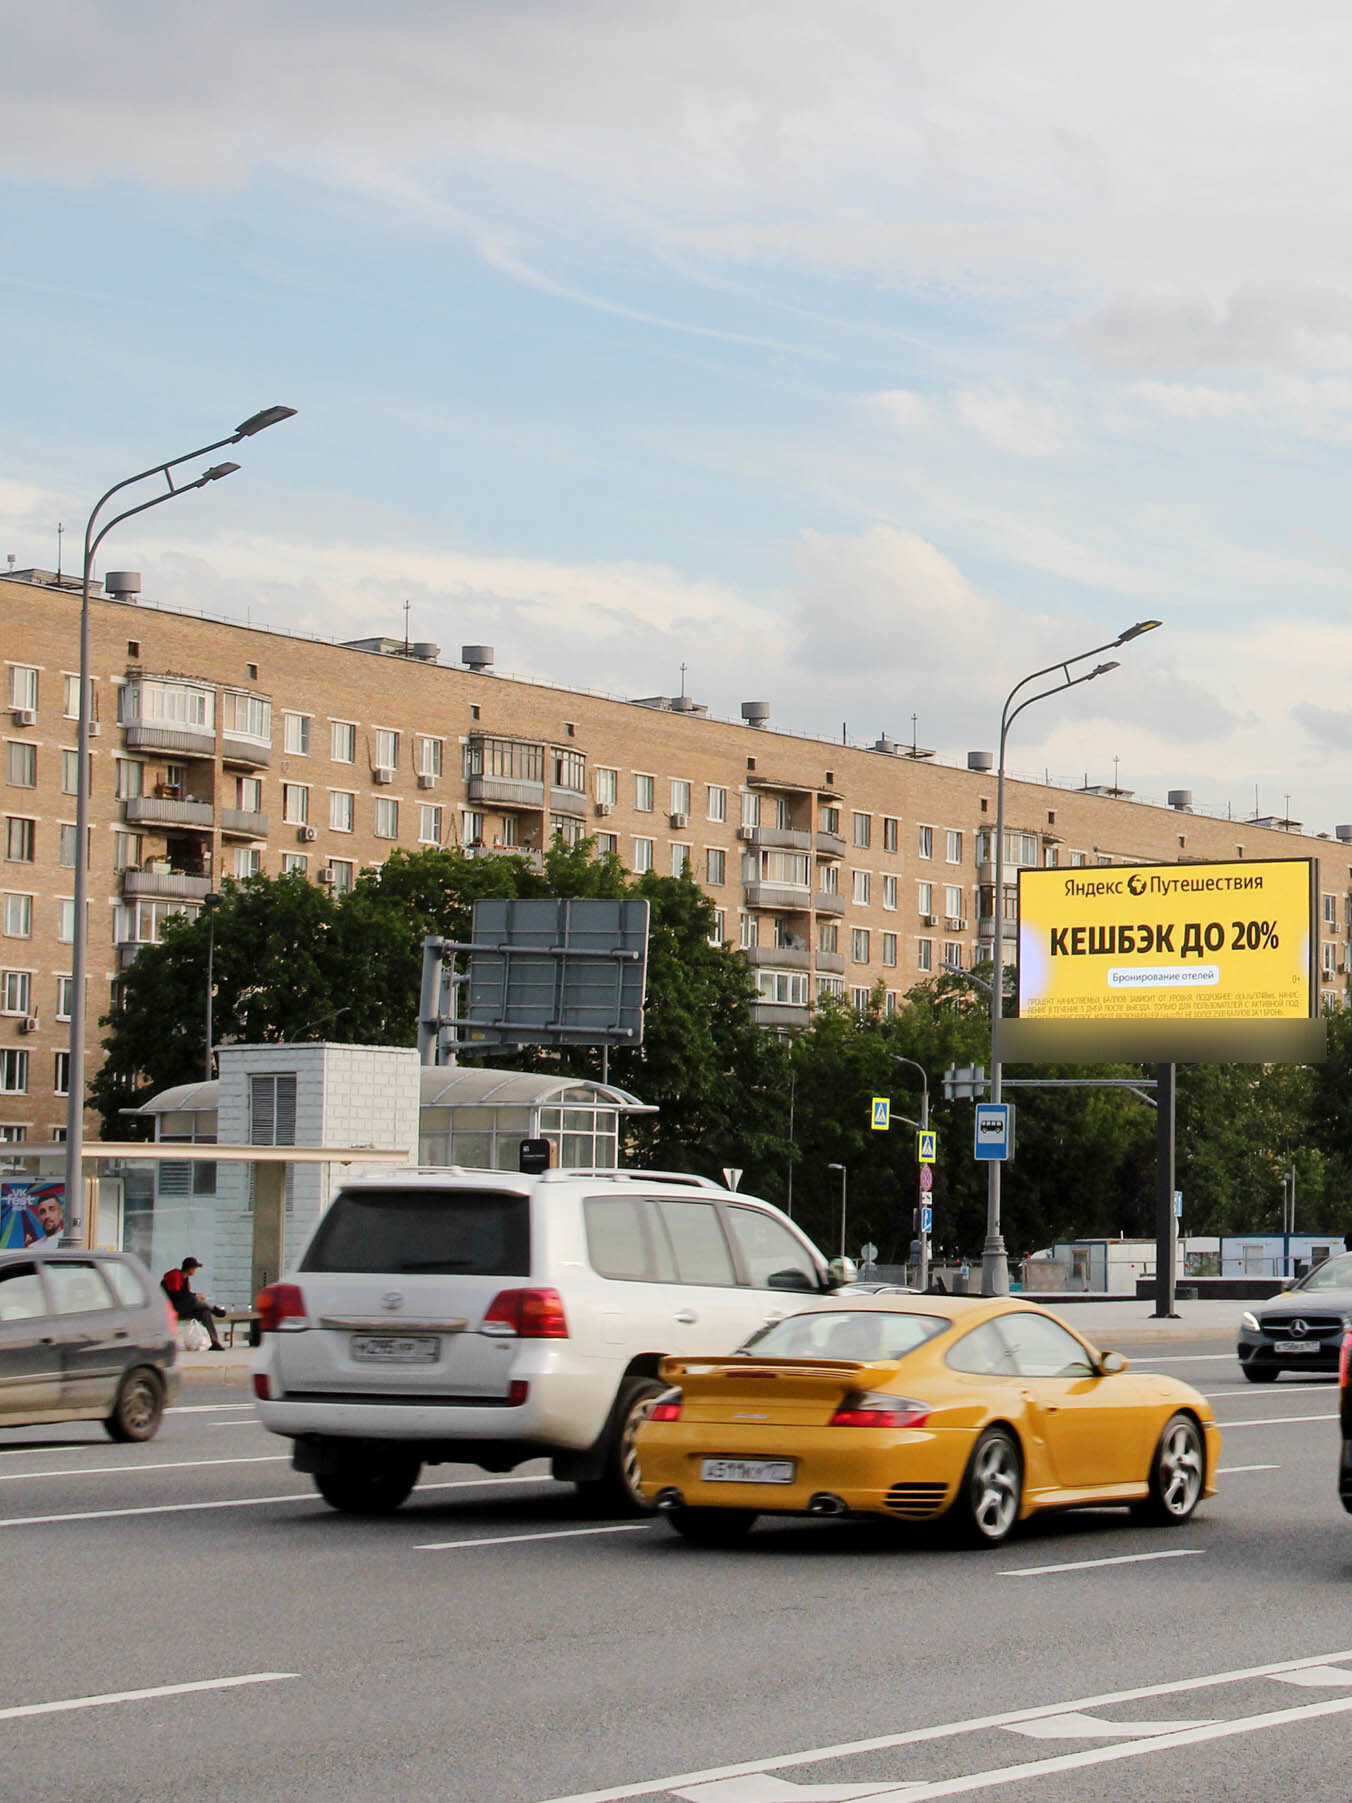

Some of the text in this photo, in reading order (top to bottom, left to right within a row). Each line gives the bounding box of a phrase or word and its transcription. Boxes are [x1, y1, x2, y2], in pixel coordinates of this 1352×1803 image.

[1064, 876, 1263, 898] Яндекс Путешествия
[1050, 920, 1279, 958] КЕШБЭК ДО 20%
[1112, 969, 1215, 983] Бронирование отелей
